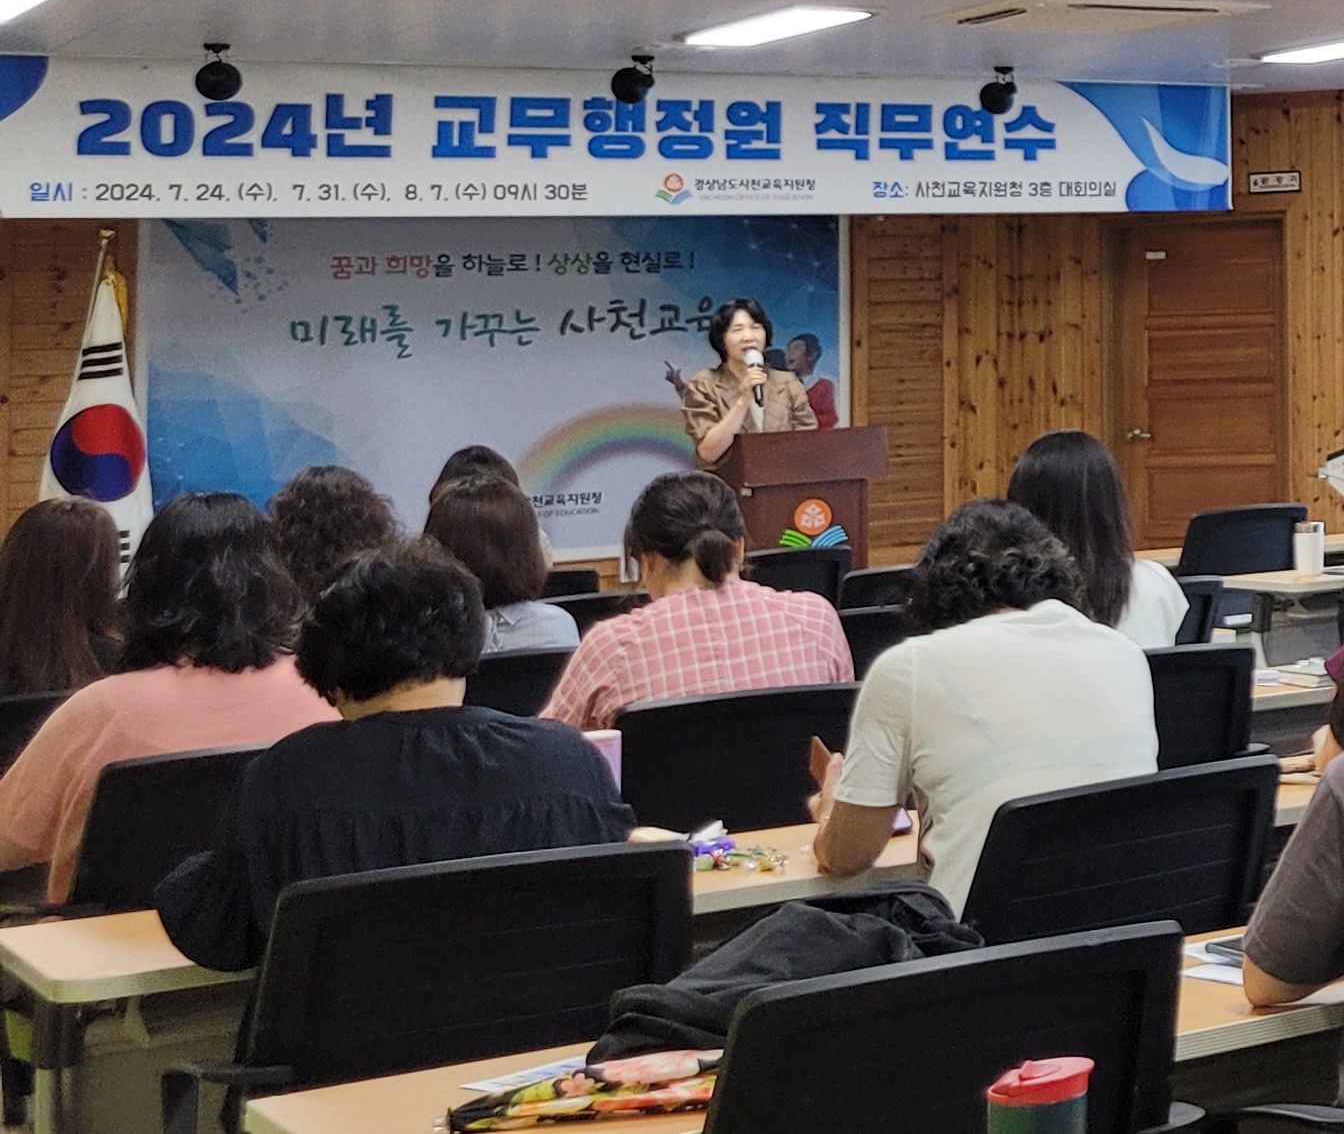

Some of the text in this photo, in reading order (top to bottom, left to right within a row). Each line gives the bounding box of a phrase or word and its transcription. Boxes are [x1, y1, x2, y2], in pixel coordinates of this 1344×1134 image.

[76, 93, 1057, 162] 2024년 교무행정원 직무연수
[95, 183, 161, 202] 2024.
[168, 184, 189, 202] 7.
[195, 183, 231, 202] 24.
[292, 184, 312, 202] 7.
[317, 183, 346, 202] 31.
[404, 184, 424, 202] 8.
[430, 184, 449, 202] 7.
[455, 182, 487, 202] (수)
[493, 182, 538, 202] 09시
[544, 182, 589, 202] 30분
[694, 178, 816, 191] 경상남도사천교육지원청
[872, 180, 1117, 199] 장소: 사천교육지원청 3층 대회의실
[331, 256, 377, 281] 꿈과
[383, 254, 456, 279] 희망을
[549, 251, 614, 275] 상상을
[290, 304, 414, 360] 미래를
[434, 309, 541, 348] 가꾸는
[527, 491, 602, 508] 천교육지원청
